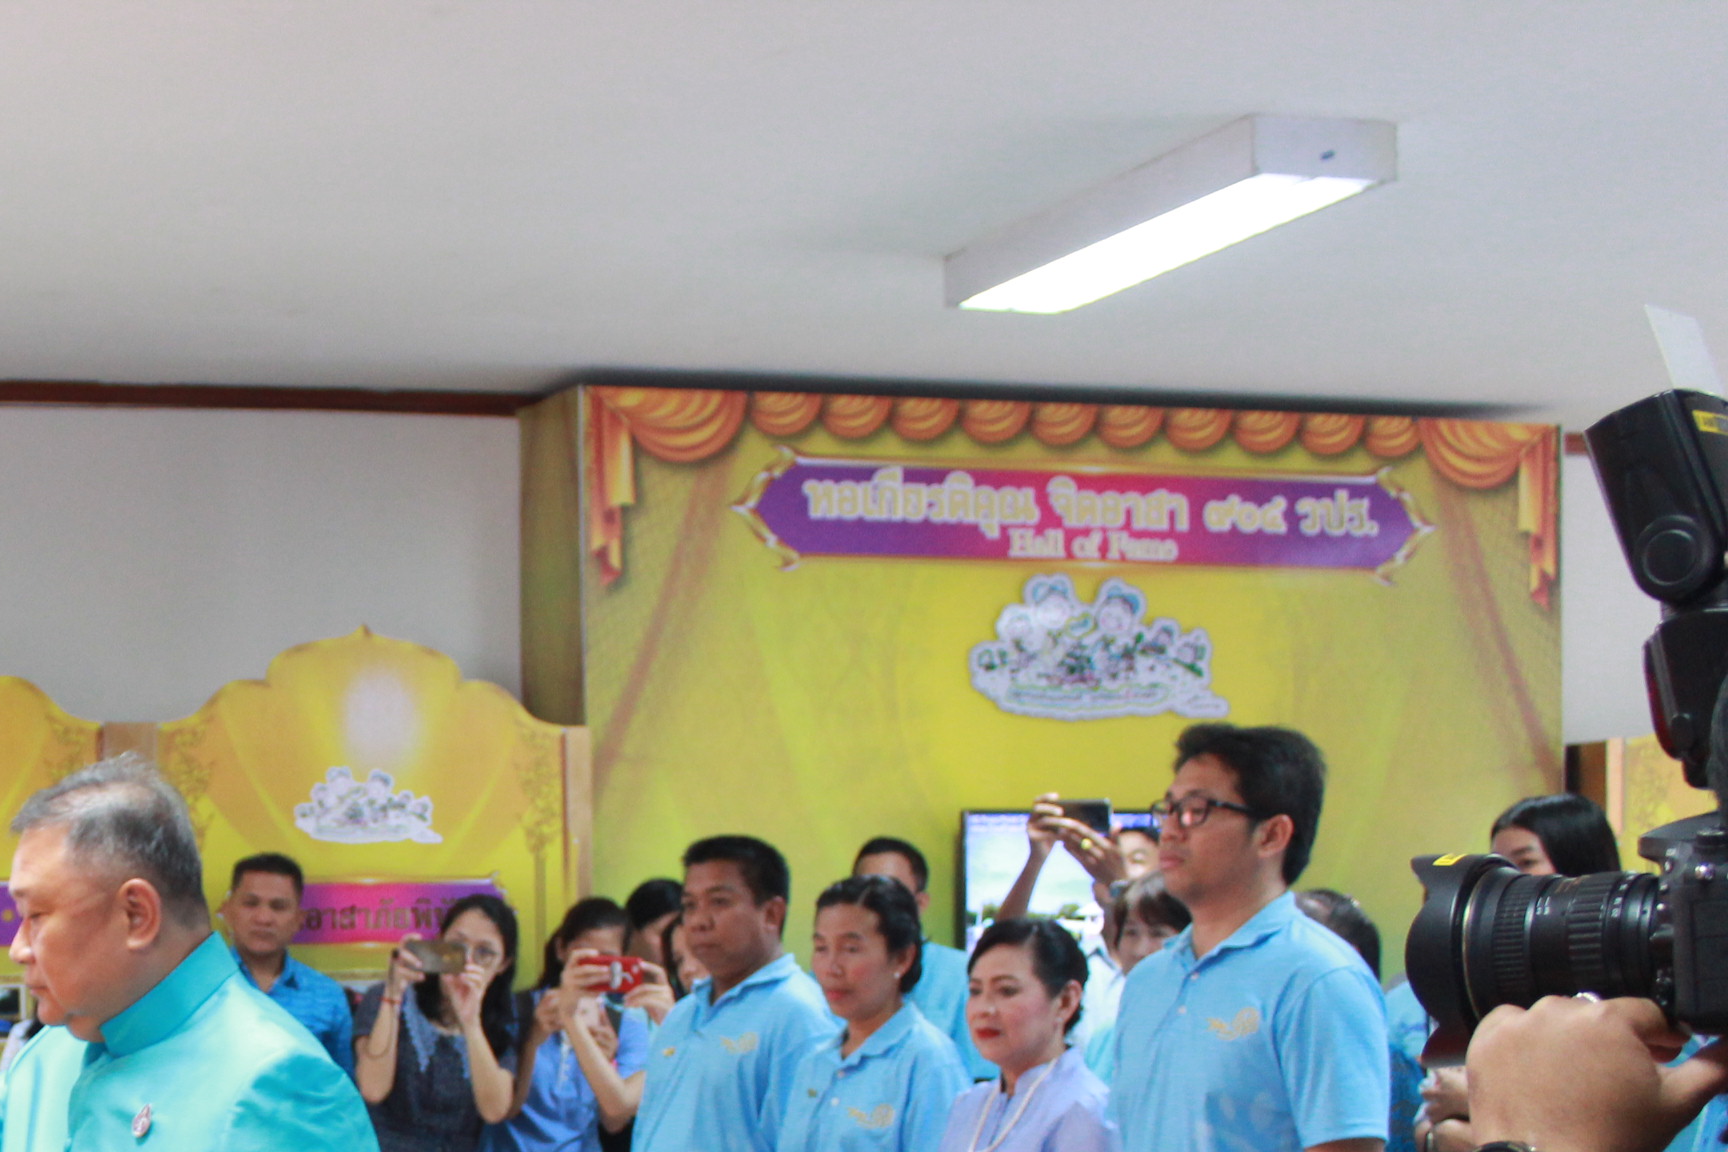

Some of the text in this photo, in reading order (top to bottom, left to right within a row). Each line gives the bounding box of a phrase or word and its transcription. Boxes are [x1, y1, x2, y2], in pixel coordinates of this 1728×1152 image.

[802, 466, 1040, 540] หอเกียรติคุณ
[1046, 475, 1189, 532] จิตอาสา
[1007, 528, 1179, 562] Hall of Fame
